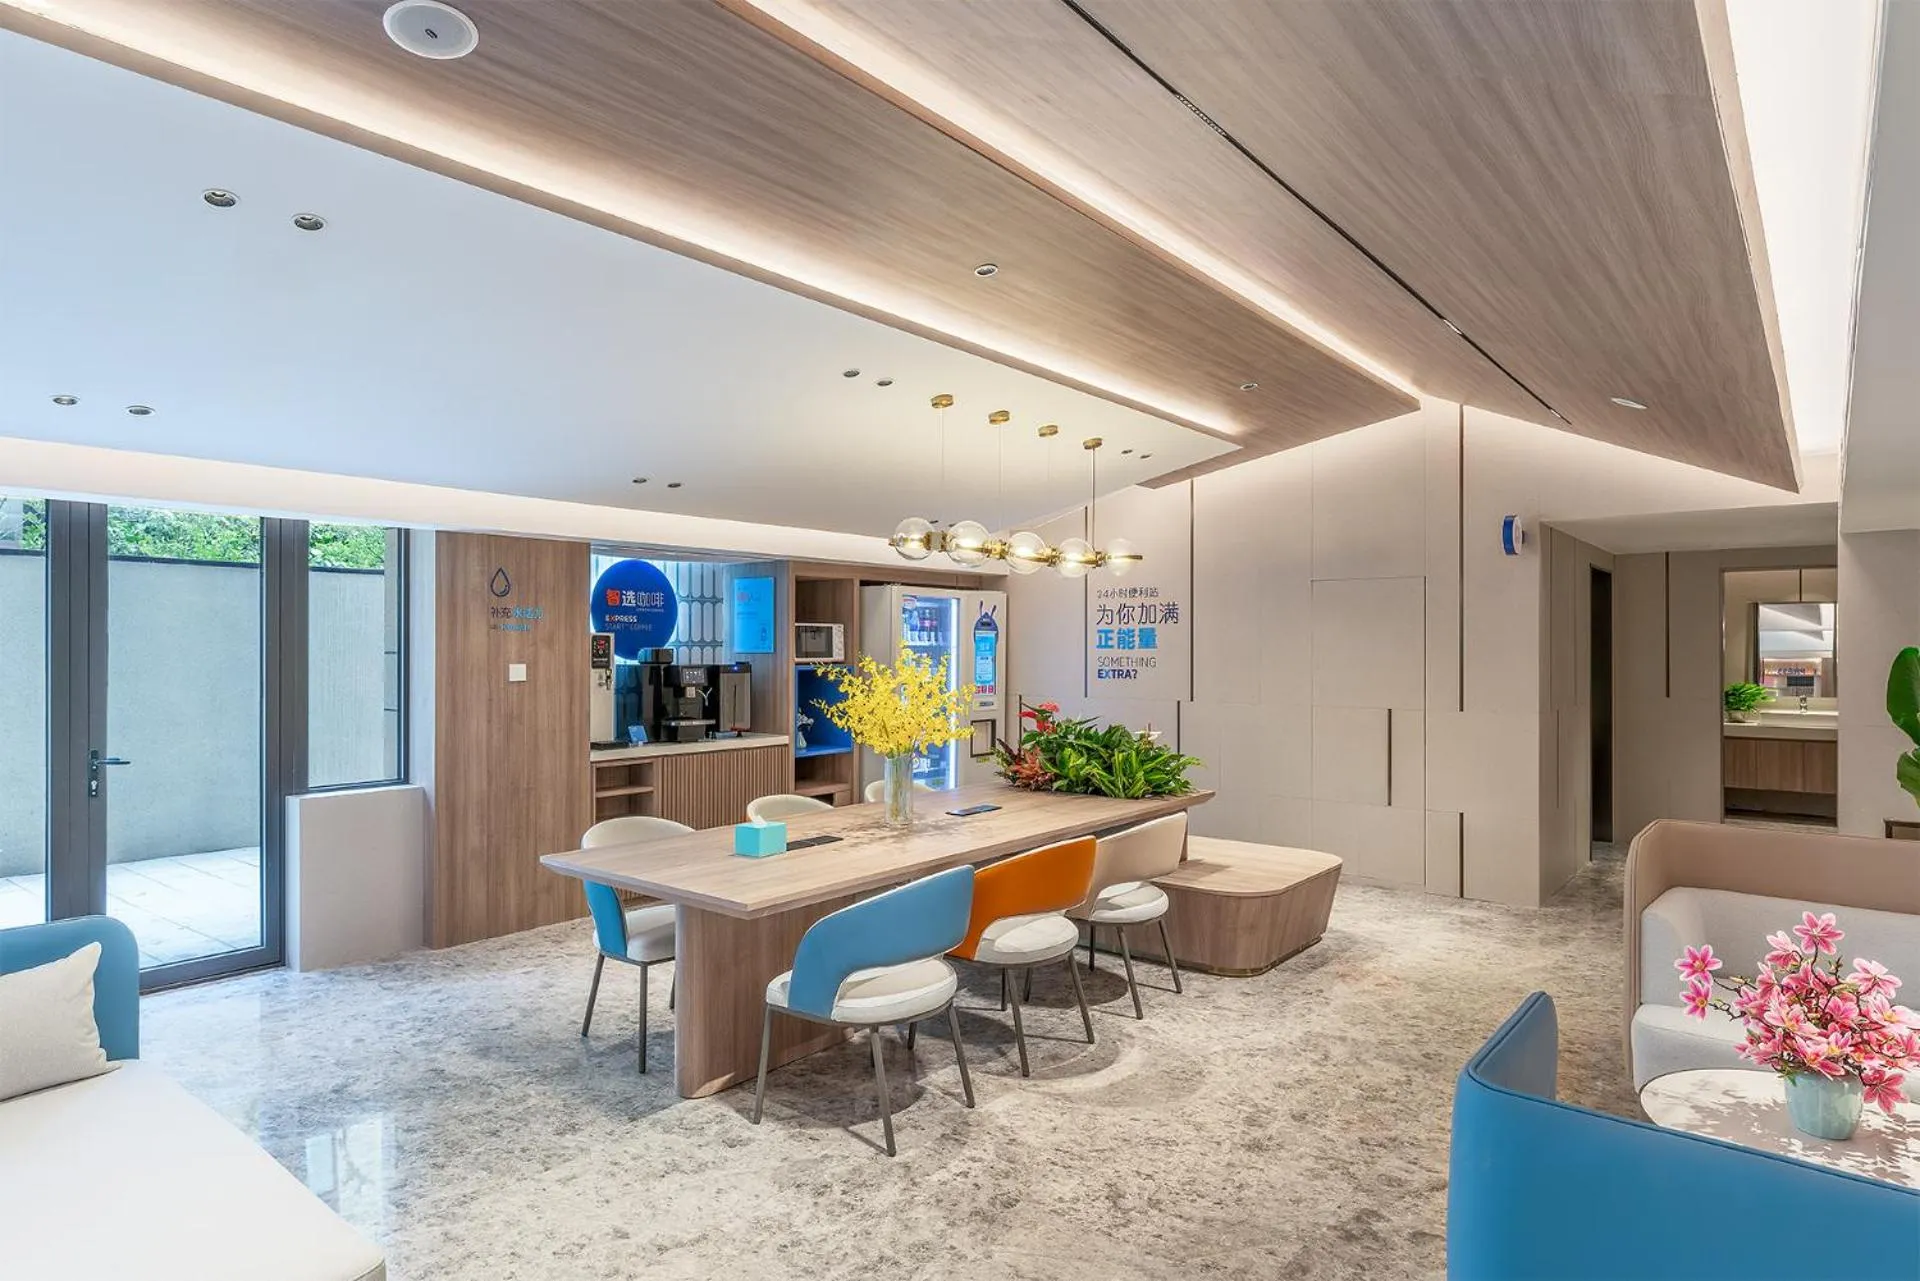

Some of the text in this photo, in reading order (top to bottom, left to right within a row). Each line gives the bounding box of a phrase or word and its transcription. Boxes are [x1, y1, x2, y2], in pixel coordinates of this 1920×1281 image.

[605, 588, 665, 607] 智选咖啡
[605, 614, 638, 623] EXPRESS
[1096, 602, 1179, 625] 为你加满
[1096, 627, 1157, 650] 正能量
[1097, 656, 1157, 668] SOMETHING
[1097, 668, 1138, 680] EXTRA?
